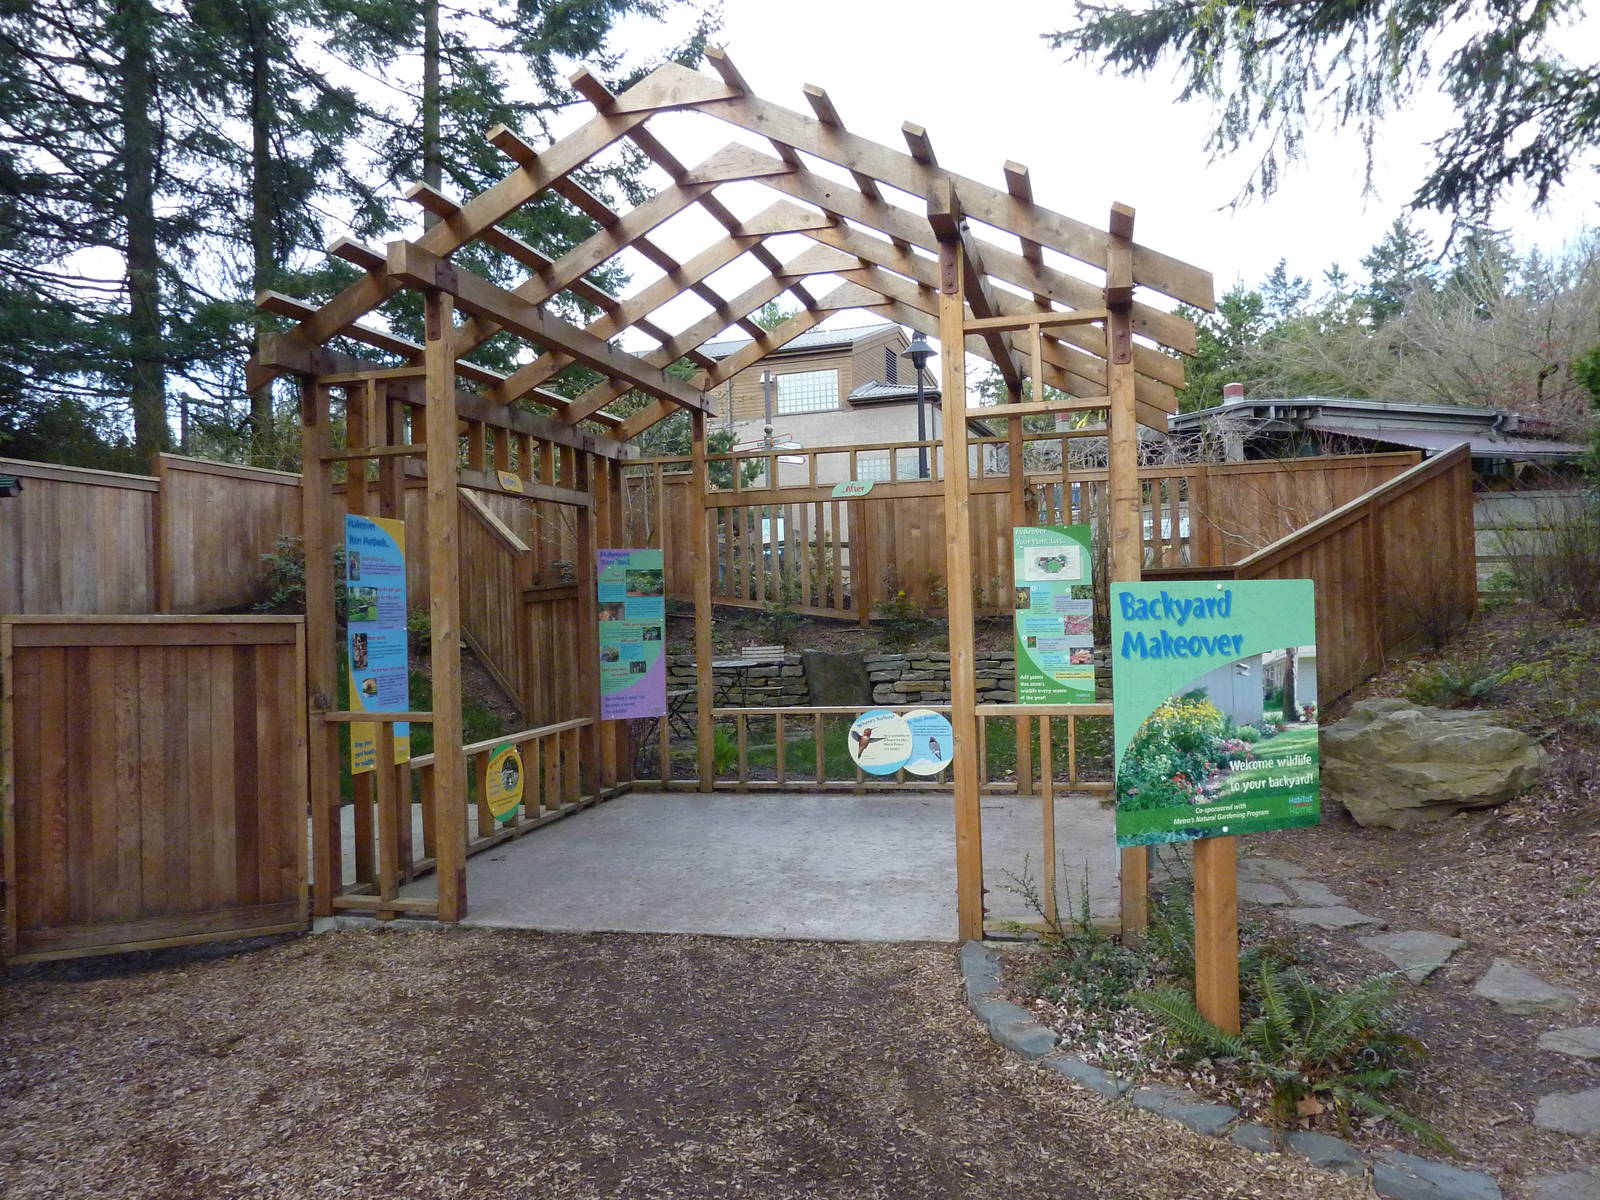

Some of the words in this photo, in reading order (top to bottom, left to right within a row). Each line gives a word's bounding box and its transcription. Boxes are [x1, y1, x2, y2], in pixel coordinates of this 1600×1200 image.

[1119, 590, 1232, 626] Backyard
[1121, 630, 1244, 660] Makeover
[1229, 759, 1274, 772] Welcome
[1276, 753, 1312, 767] wildlife
[1230, 781, 1240, 792] to
[1242, 779, 1267, 793] your
[1268, 772, 1314, 789] backyard!
[1173, 817, 1195, 825] Metro's
[1195, 814, 1216, 823] Natural
[1217, 811, 1246, 821] Gardening
[1246, 809, 1270, 818] Program
[1195, 804, 1233, 814] Co-sponsored
